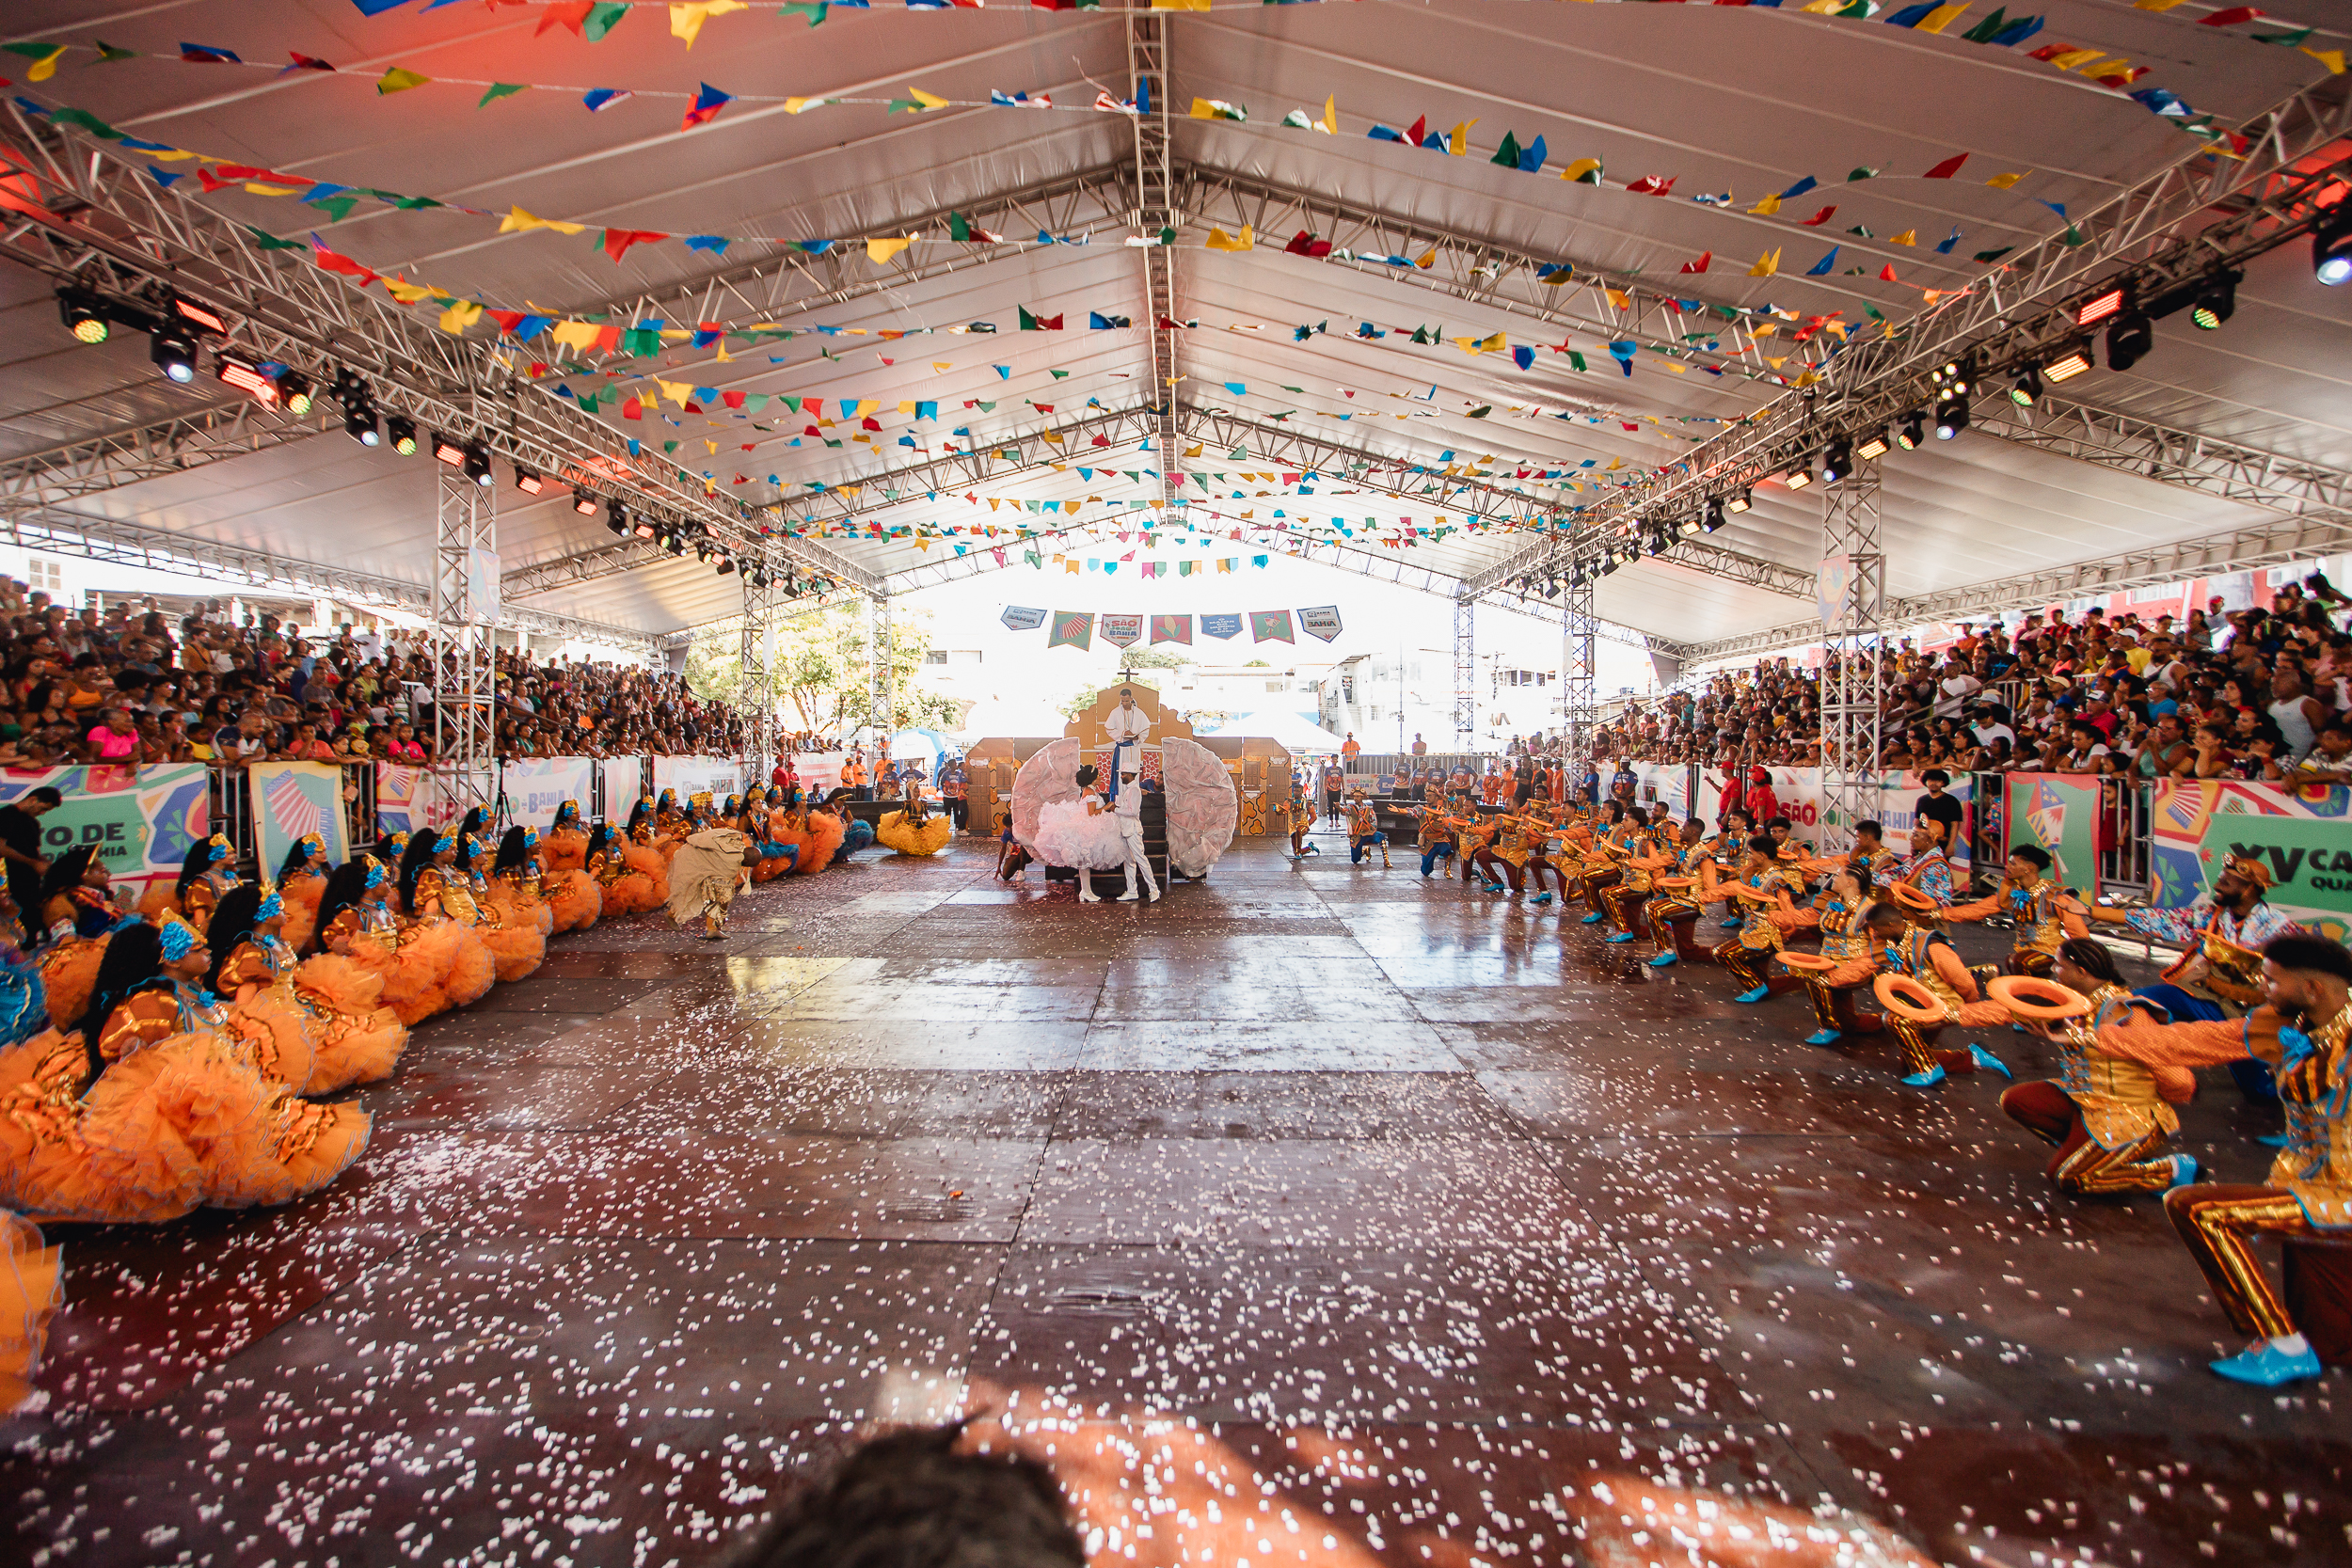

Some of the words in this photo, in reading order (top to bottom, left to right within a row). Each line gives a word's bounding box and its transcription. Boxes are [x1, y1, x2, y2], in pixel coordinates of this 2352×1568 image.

[710, 779, 735, 793] BAHIA
[529, 790, 565, 814] BAHIA
[1779, 799, 1817, 827] SÃO
[82, 822, 125, 844] DE
